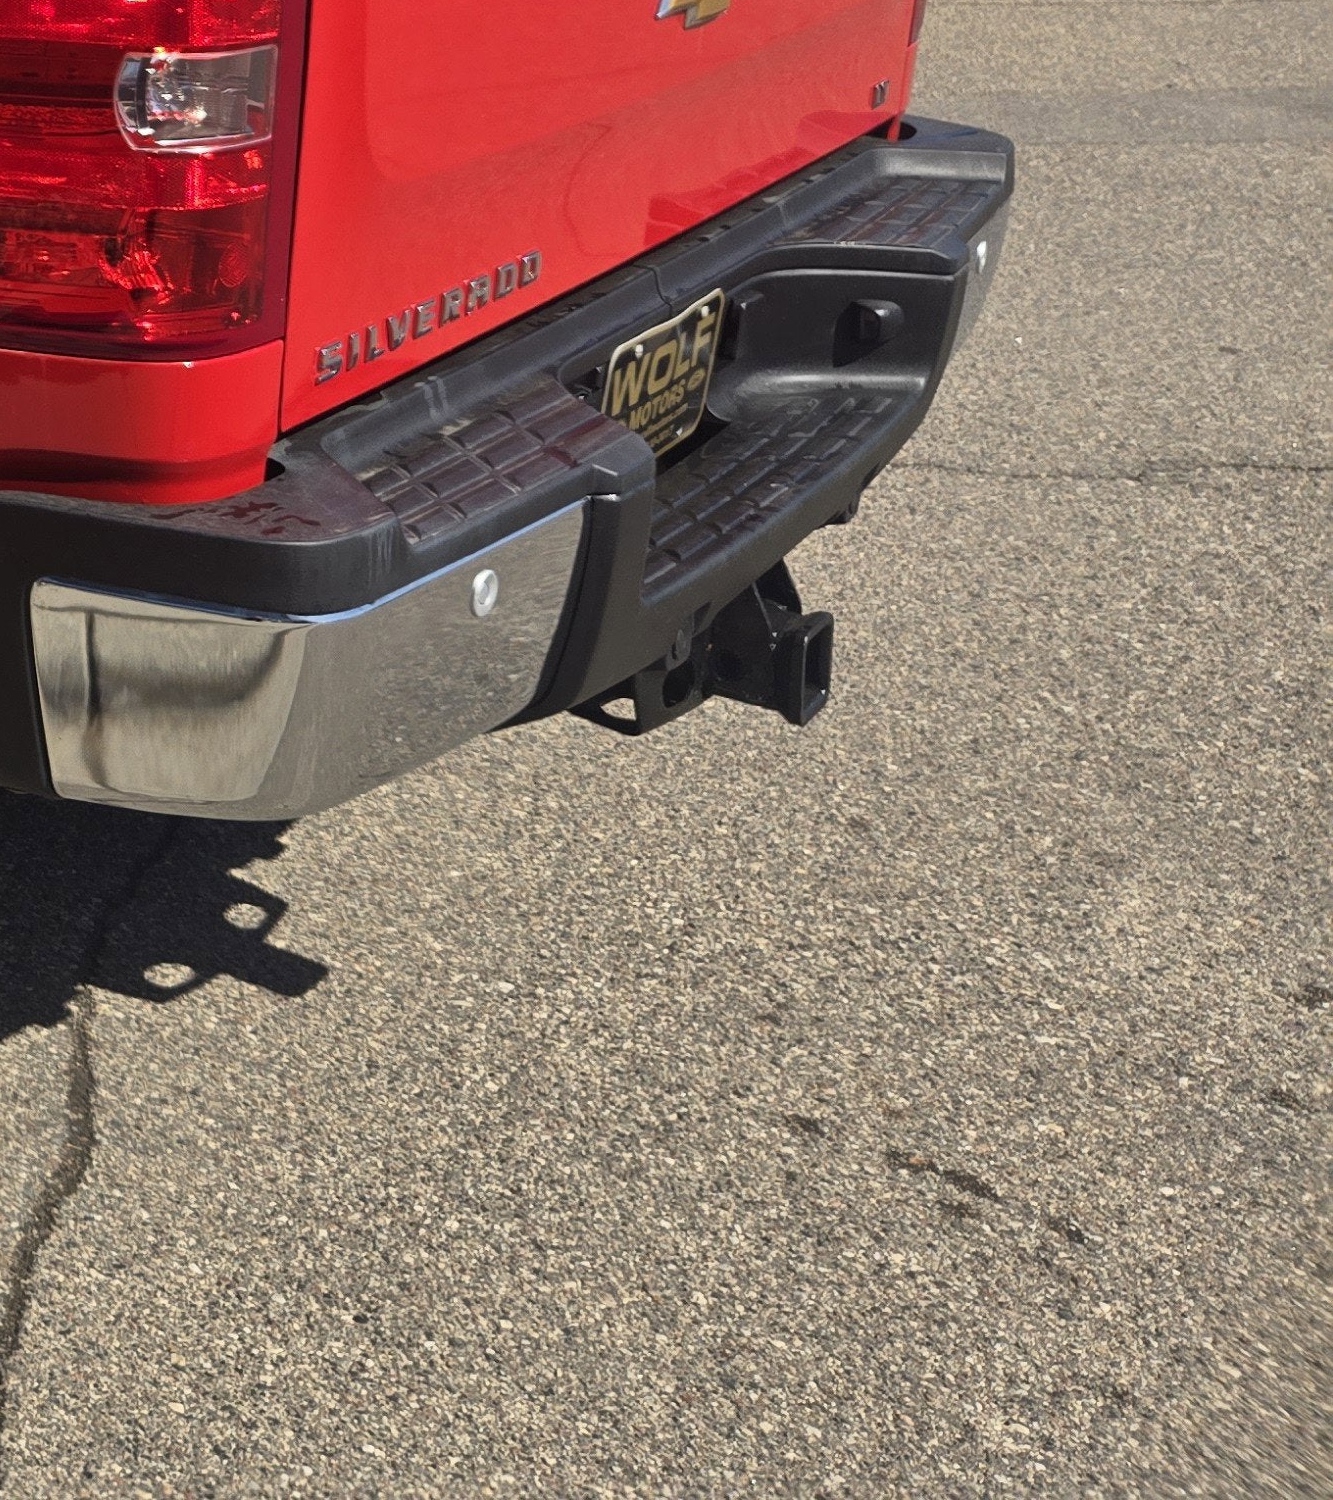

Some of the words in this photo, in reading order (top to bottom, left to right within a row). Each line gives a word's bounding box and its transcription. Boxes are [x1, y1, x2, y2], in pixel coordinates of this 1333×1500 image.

[315, 250, 542, 387] SILVERADO
[611, 311, 716, 417] WOLF
[629, 379, 686, 431] MOTORS
